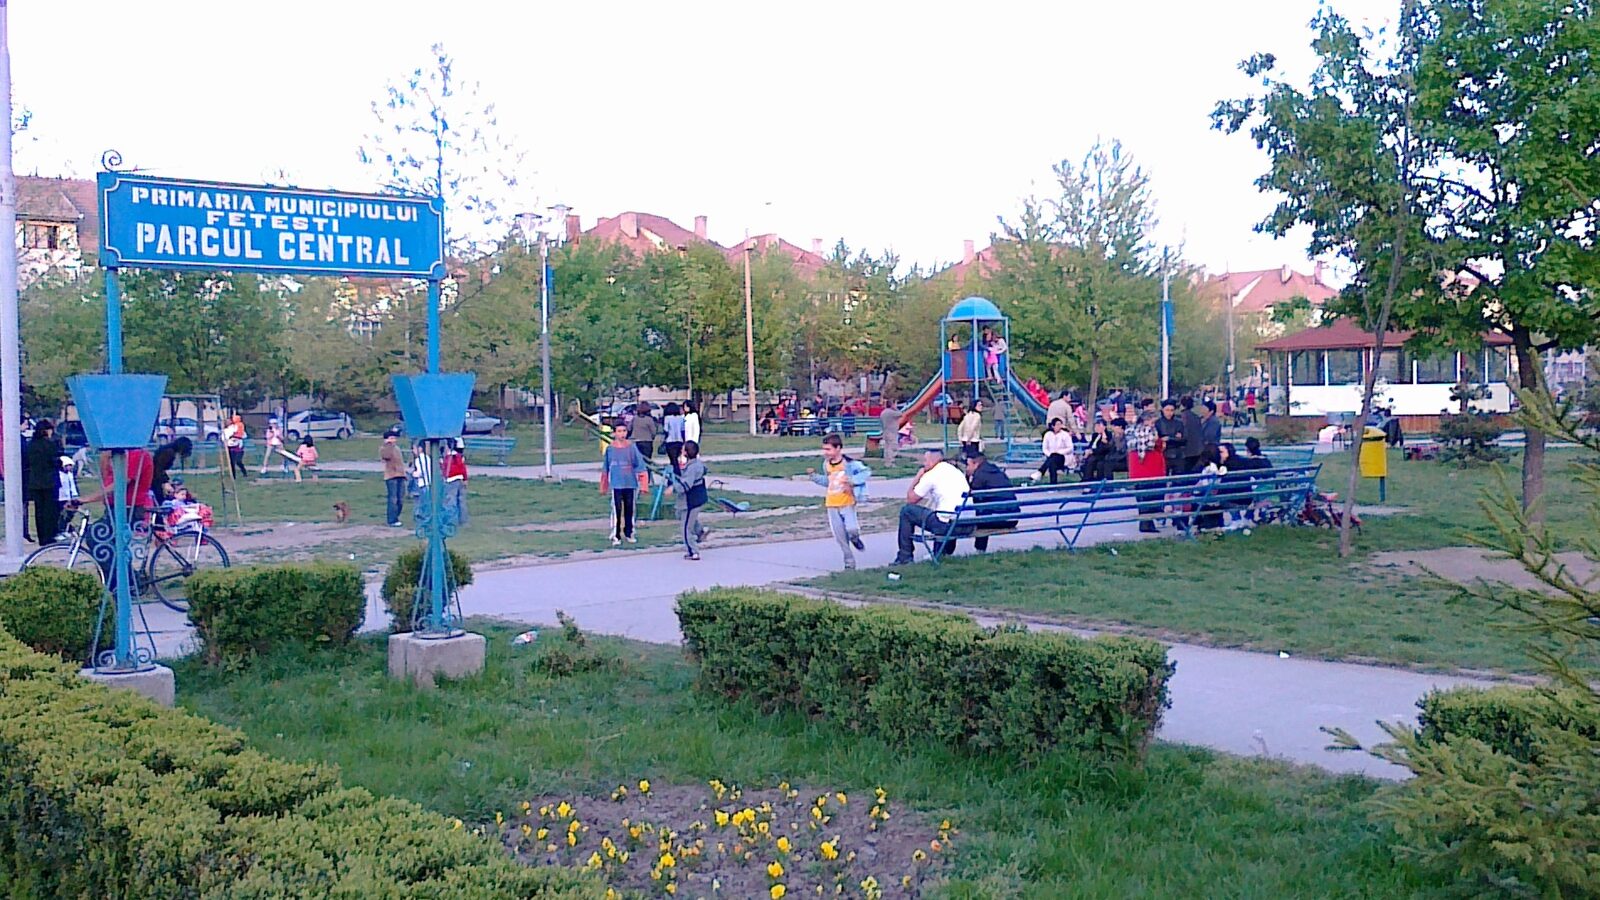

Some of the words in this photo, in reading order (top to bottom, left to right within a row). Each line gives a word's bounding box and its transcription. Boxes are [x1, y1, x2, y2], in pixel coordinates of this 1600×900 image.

[132, 187, 255, 212] PRIMARIA
[265, 198, 418, 222] MUNICIPIULUI
[206, 211, 339, 233] FETESTI
[136, 223, 262, 259] PARCUL
[278, 233, 410, 265] CENTRAL
